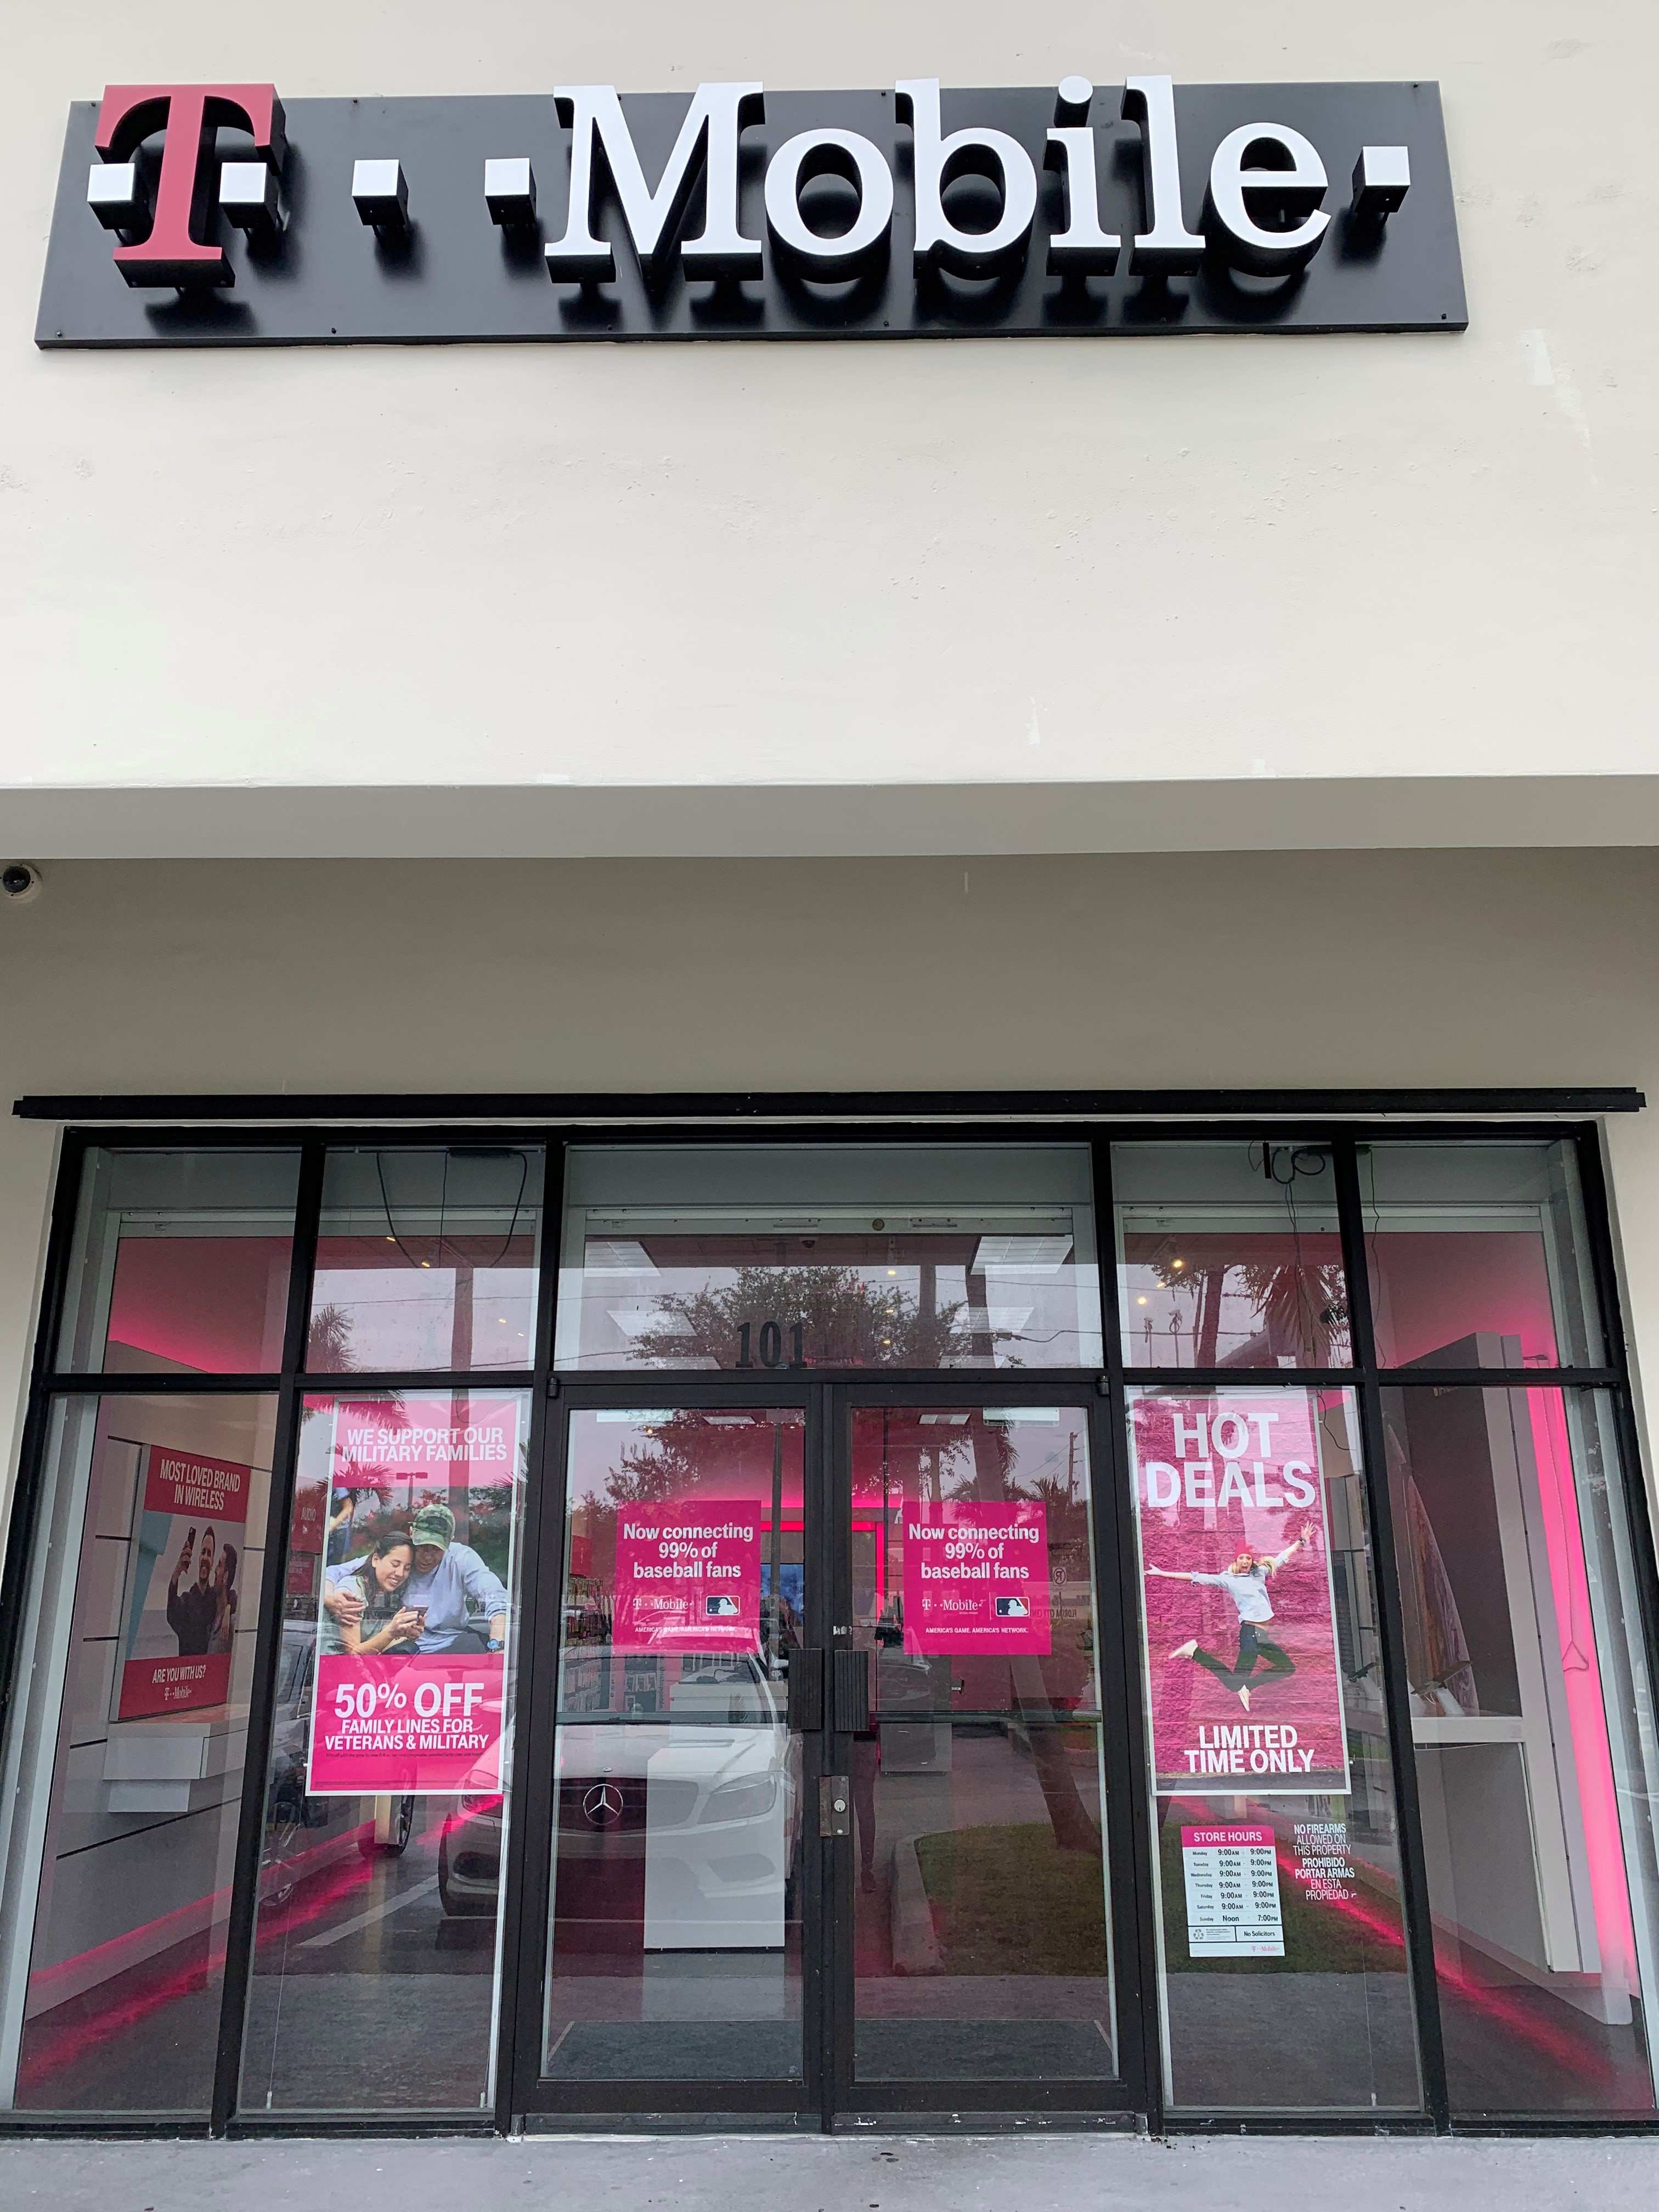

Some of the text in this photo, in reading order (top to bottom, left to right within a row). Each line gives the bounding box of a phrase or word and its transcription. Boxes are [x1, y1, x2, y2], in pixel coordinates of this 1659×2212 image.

[543, 75, 1332, 261] Mobile
[735, 1321, 808, 1368] 101
[347, 1427, 503, 1446] WE SUPPORT OUR
[1173, 1412, 1278, 1458] HOT
[342, 1443, 507, 1462] MILITARY FAMILIES
[160, 1459, 240, 1492] MOST LOVED BRAND
[1146, 1460, 1316, 1508] DEALS
[174, 1484, 224, 1511] IN WIRELESS
[301, 1507, 316, 1521] AUDIO
[624, 1522, 753, 1542] Now connecting
[909, 1523, 1039, 1543] Now connecting
[659, 1542, 718, 1558] 99% of
[945, 1542, 1004, 1559] 99% of
[633, 1562, 741, 1578] baseball fans
[921, 1562, 1030, 1579] baseball fans
[653, 1599, 689, 1610] Mobile
[942, 1599, 979, 1611] Mobile
[152, 1664, 206, 1684] ARE YOU WITH US?
[334, 1682, 484, 1718] 50% OFF
[341, 1718, 473, 1734] FAMILY LINES FOR
[325, 1734, 489, 1750] VETERANS & MILITARY
[1199, 1725, 1297, 1749] LIMITED
[1184, 1748, 1315, 1773] TIME ONLY
[1193, 1831, 1262, 1842] STORE HOURS
[1294, 1823, 1346, 1834] NO FIREARMS
[1297, 1833, 1346, 1845] ALLOWED ON
[1293, 1844, 1351, 1855] THIS PROPERTY
[1302, 1857, 1345, 1867] PROHIBIDO
[1295, 1867, 1355, 1878] PORTAR ARMAS
[1311, 1879, 1342, 1889] EN ESTA
[1306, 1889, 1349, 1900] PROPIEDAD
